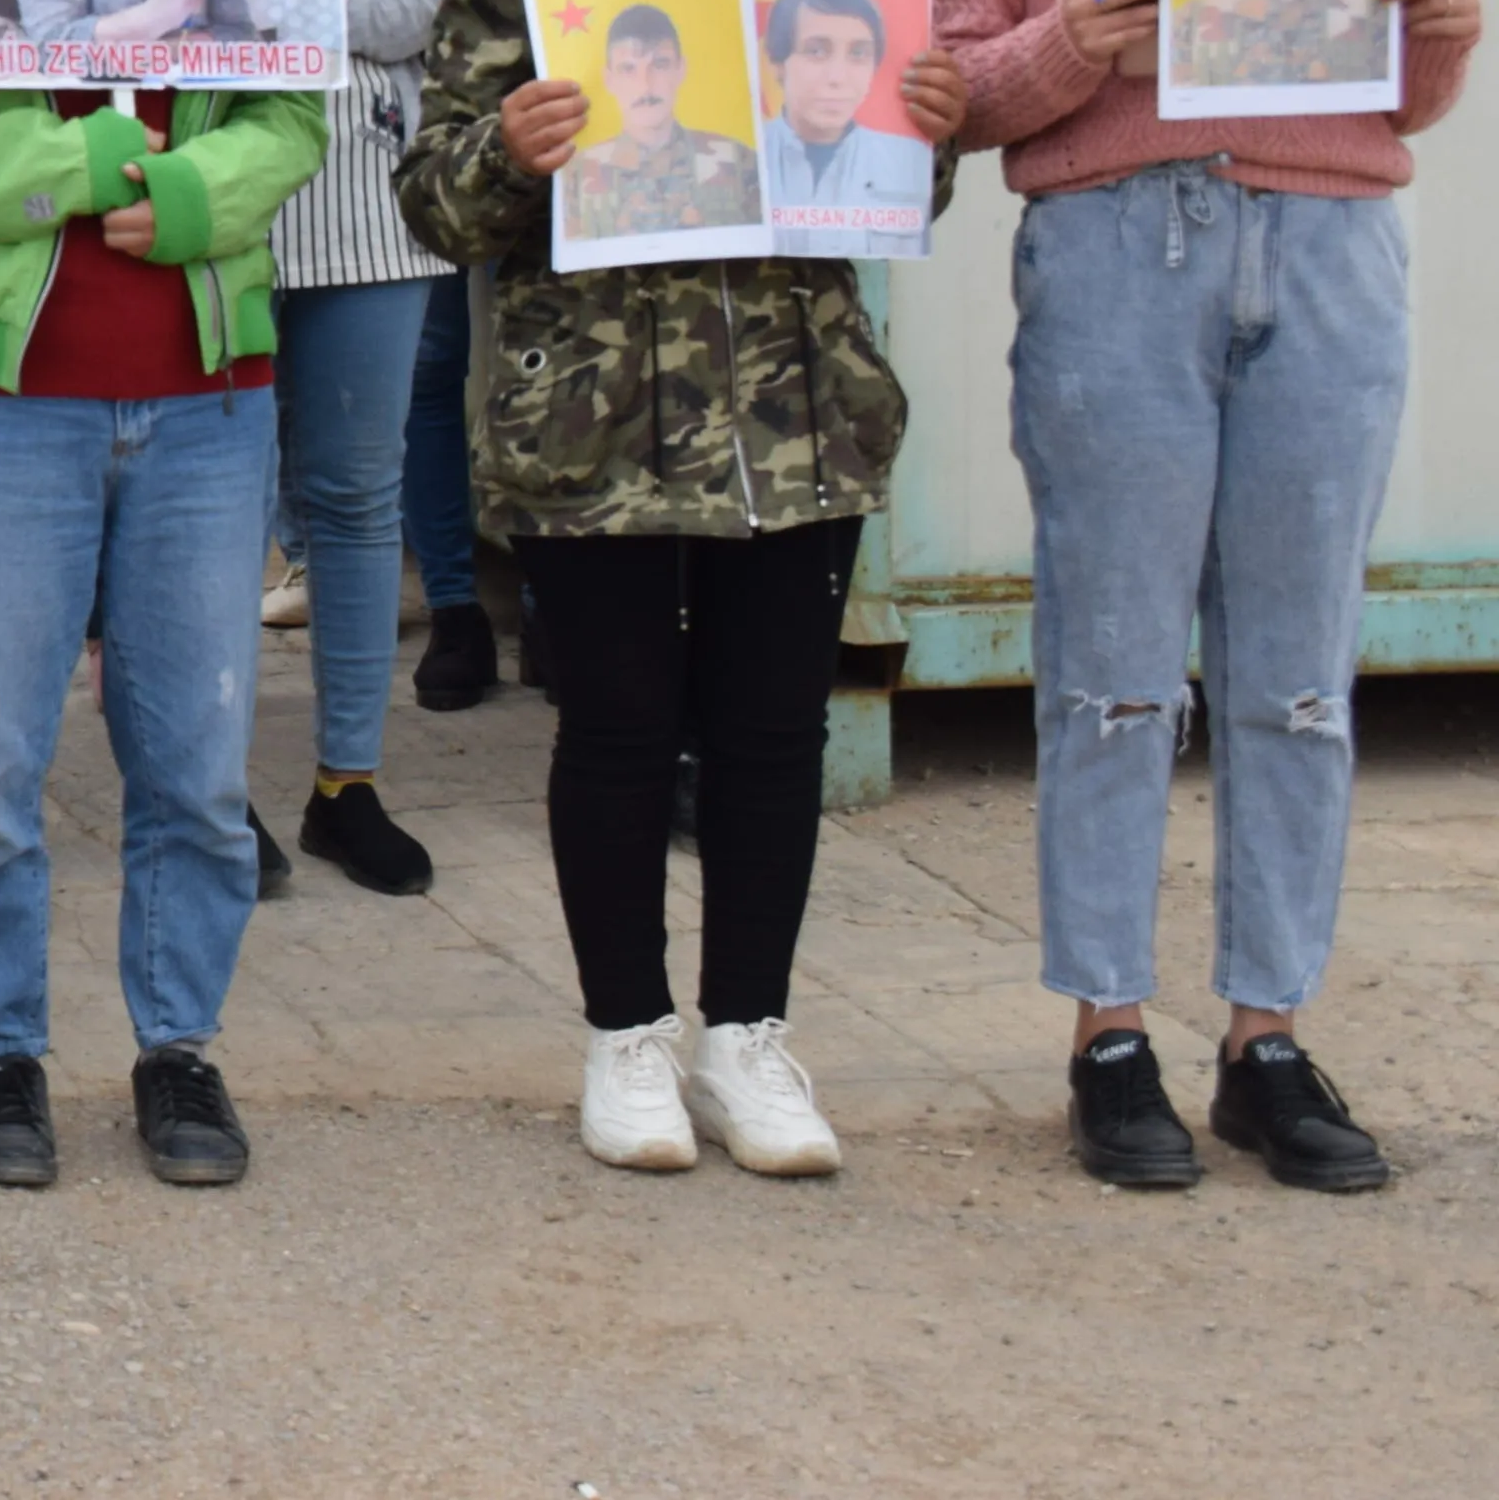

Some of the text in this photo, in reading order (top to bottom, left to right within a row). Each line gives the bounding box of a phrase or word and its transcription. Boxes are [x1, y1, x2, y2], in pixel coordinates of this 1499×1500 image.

[47, 43, 171, 76] ZEYNEB
[182, 43, 325, 76] MIHEMED
[851, 207, 921, 229] ZAGROS
